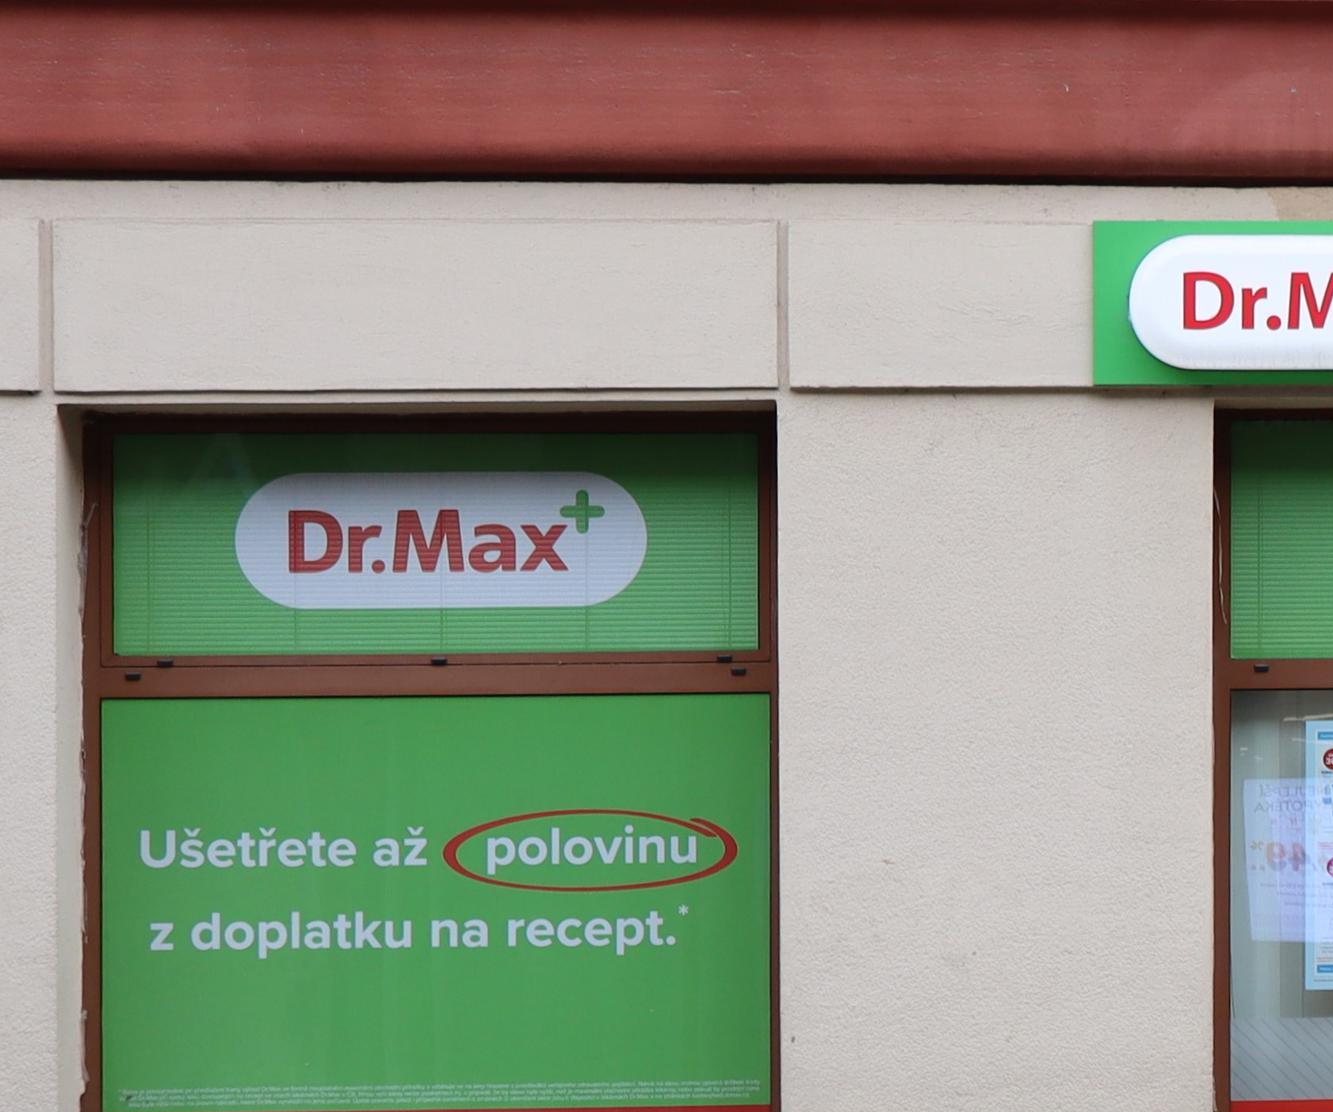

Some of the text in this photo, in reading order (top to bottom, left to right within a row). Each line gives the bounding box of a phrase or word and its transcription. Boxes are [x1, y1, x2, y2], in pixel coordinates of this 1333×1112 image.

[139, 825, 699, 875] Ušetřete až polovinu
[149, 922, 175, 952] z
[191, 911, 413, 960] doplatku
[429, 918, 490, 949] na
